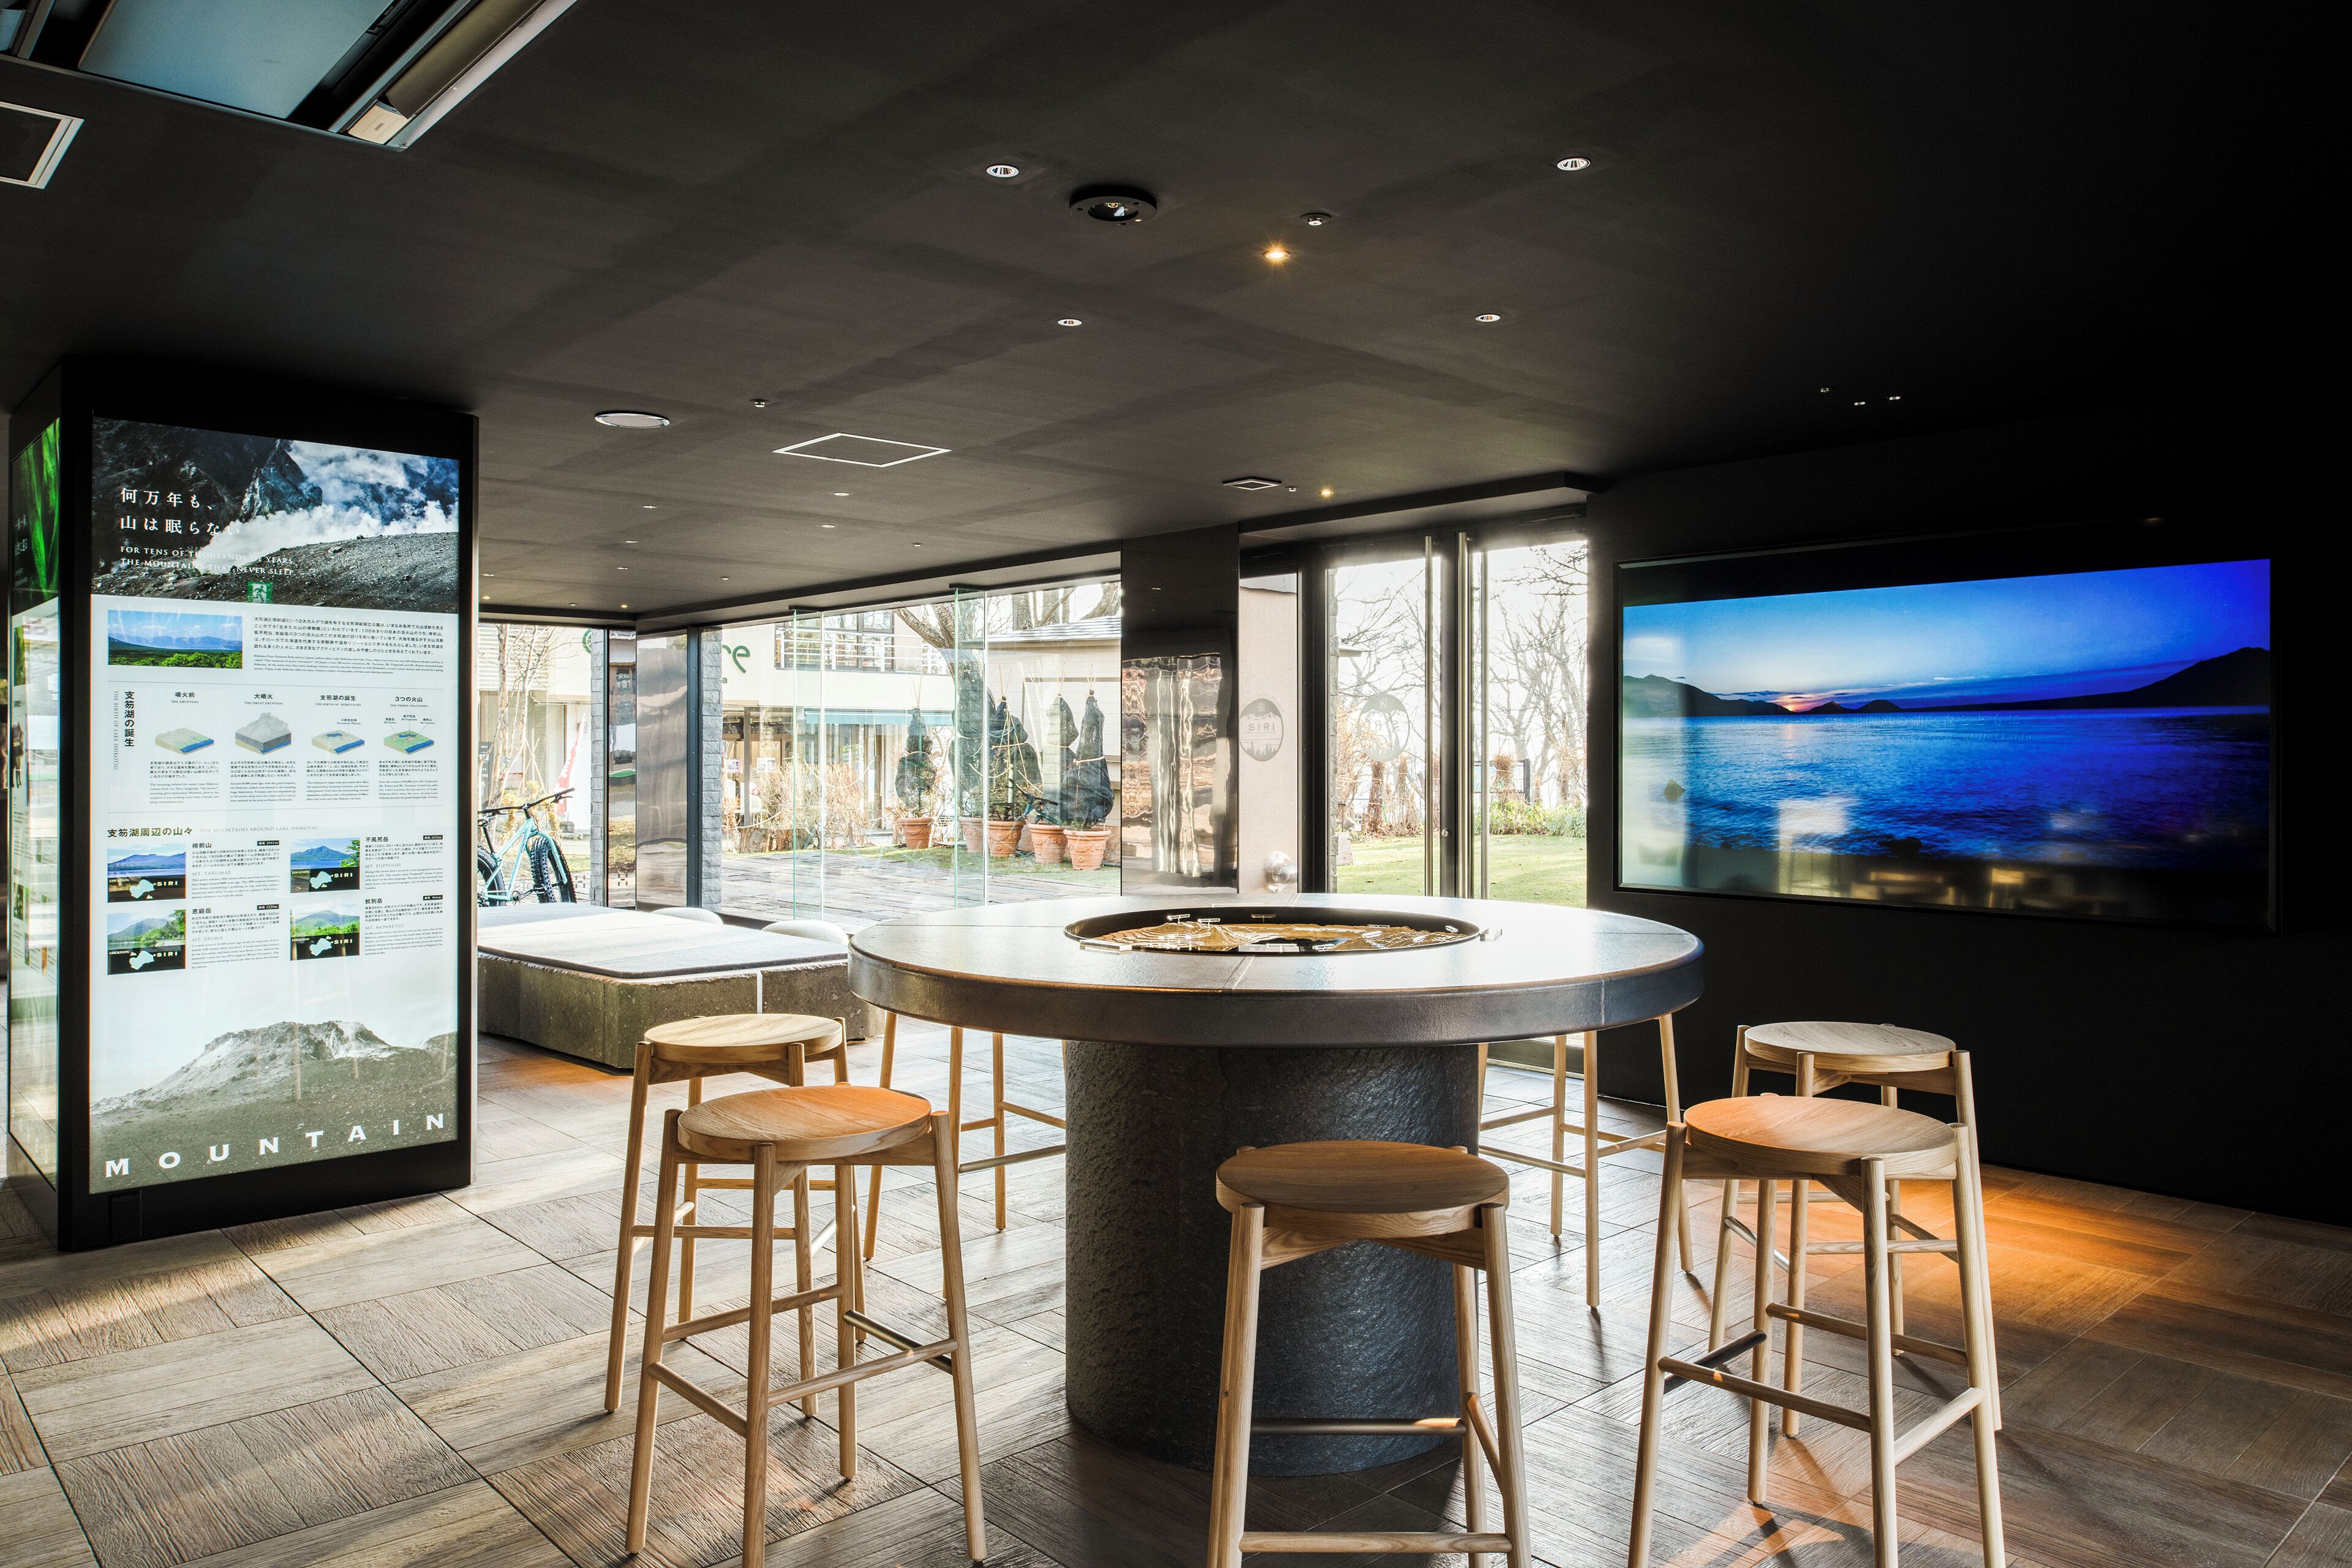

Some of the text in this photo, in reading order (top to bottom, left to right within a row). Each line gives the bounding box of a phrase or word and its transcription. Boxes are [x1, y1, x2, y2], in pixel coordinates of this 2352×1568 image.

[121, 487, 213, 510] 何万年も、
[120, 514, 239, 538] 山は眠らない
[189, 551, 246, 561] THOUSANDS
[144, 559, 204, 570] MOUNTAINS
[236, 565, 265, 574] NEVER
[124, 690, 135, 747] 支笏湖の誕生
[1248, 723, 1275, 731] SIRI
[107, 826, 192, 838] 支笏湖周辺の山々
[105, 1114, 444, 1178] MOUNTAIN
